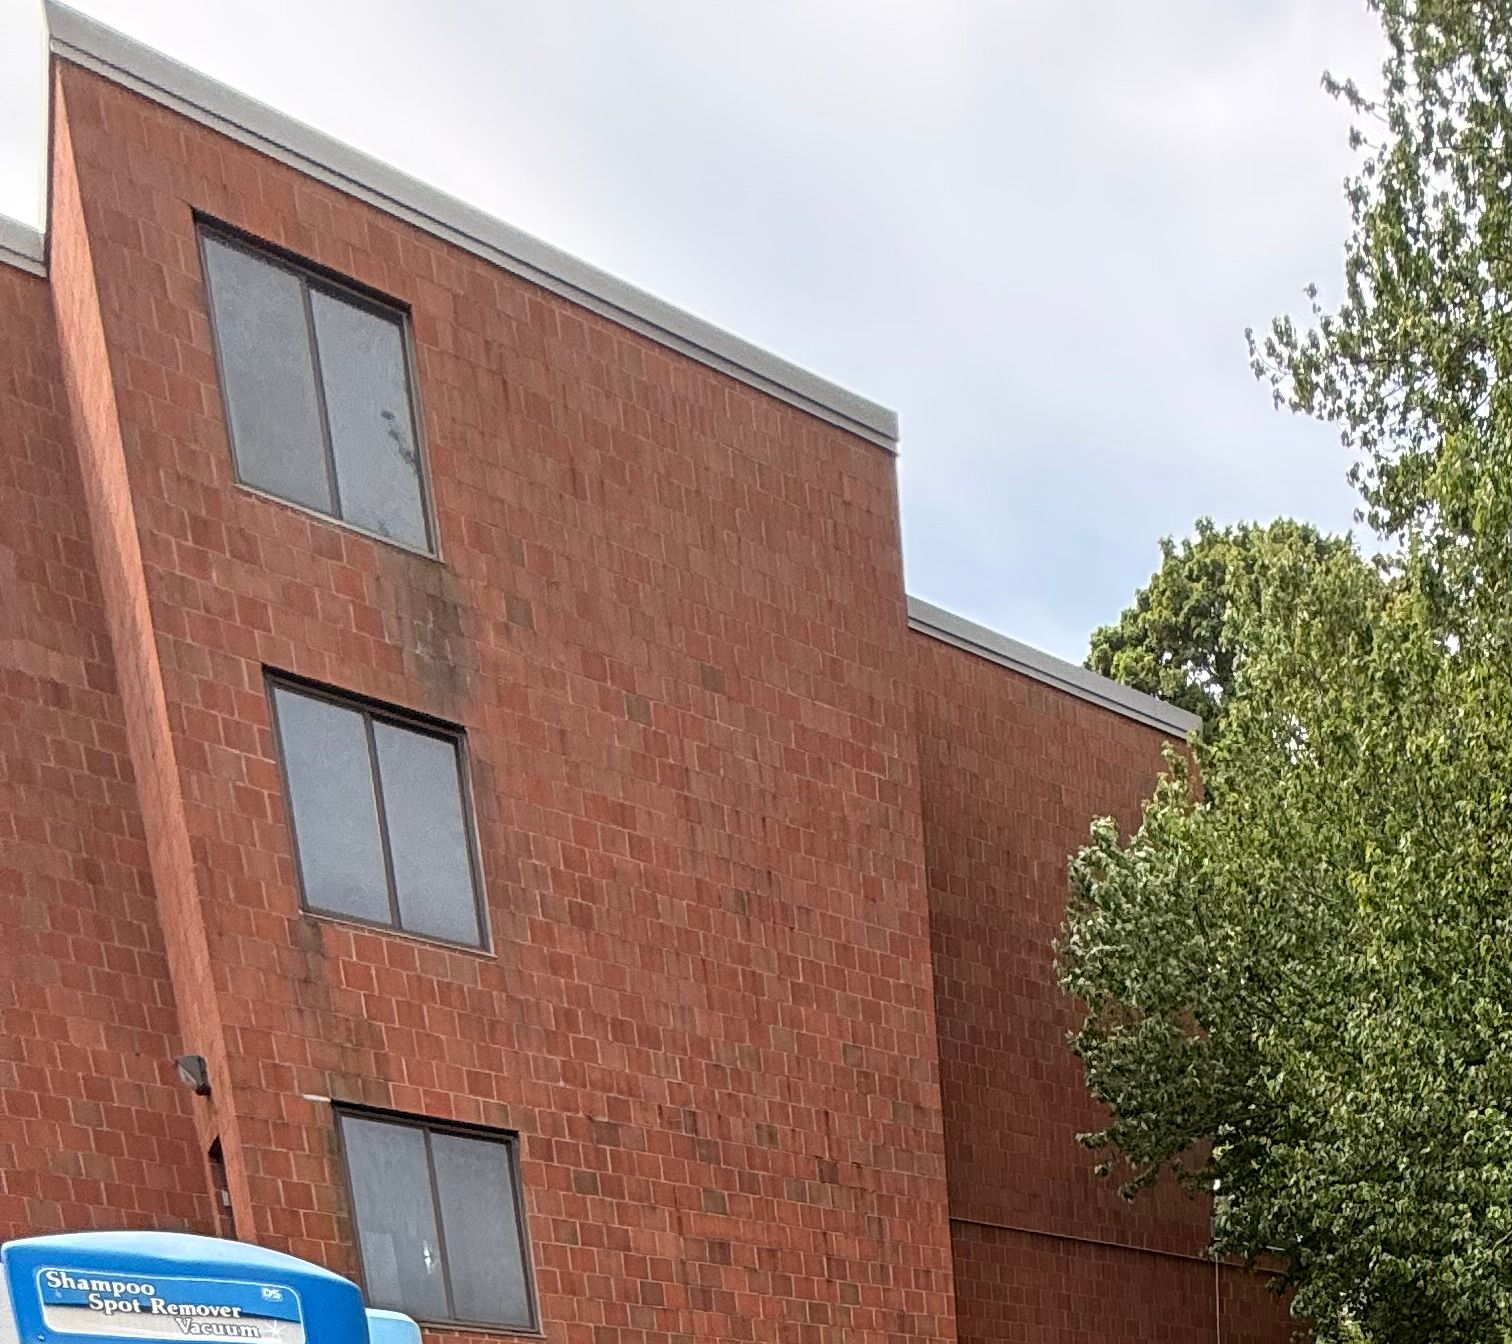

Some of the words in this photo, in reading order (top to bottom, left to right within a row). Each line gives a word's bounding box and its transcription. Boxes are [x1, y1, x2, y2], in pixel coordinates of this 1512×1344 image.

[45, 1270, 156, 1298] Shampoo
[88, 1293, 142, 1316] Spot
[150, 1297, 242, 1318] Remover
[175, 1317, 261, 1338] Vacuum
